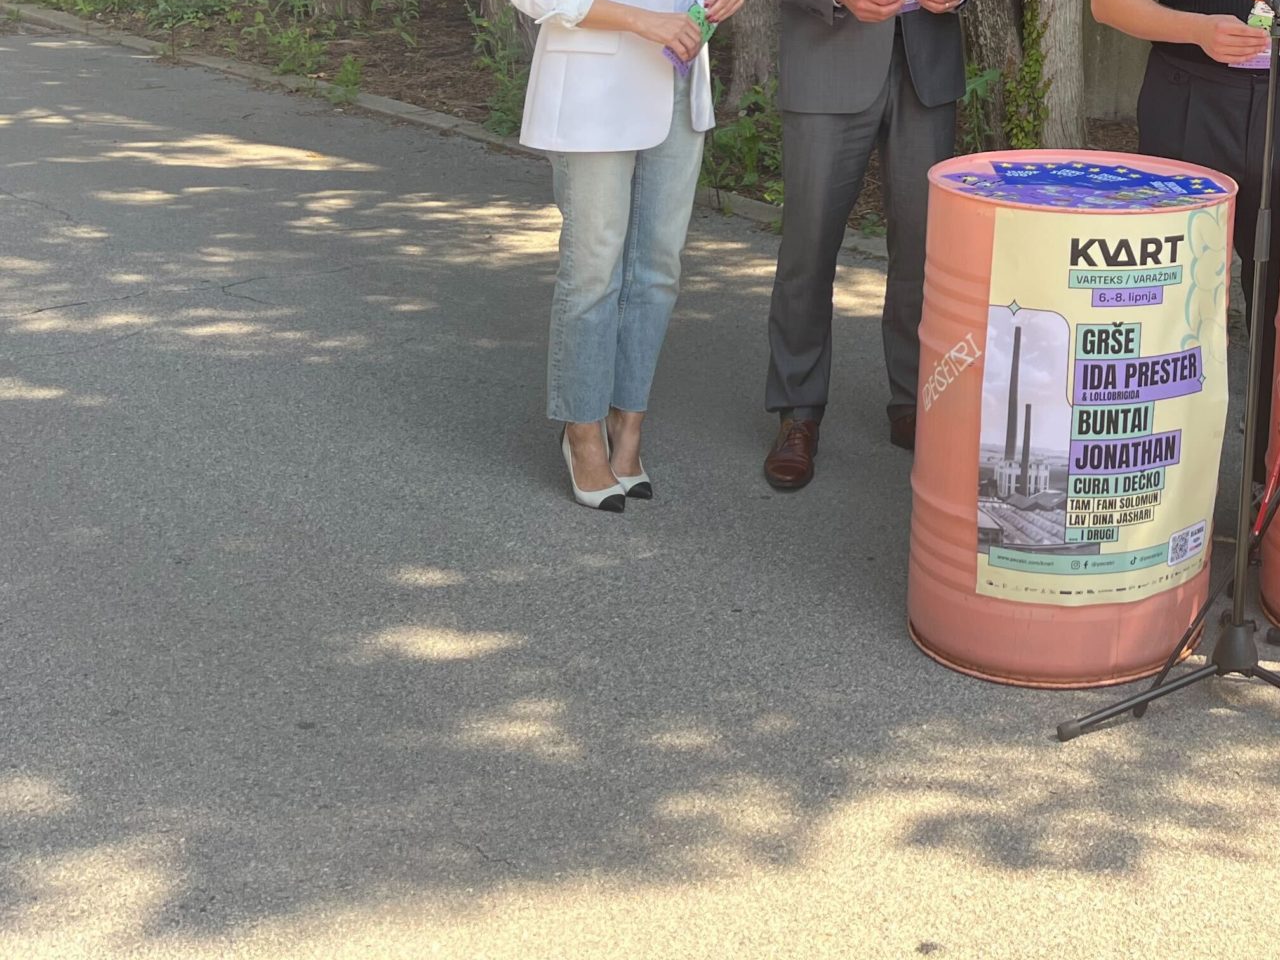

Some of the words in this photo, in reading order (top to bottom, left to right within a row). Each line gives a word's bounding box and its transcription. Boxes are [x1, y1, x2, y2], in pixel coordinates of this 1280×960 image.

[1070, 235, 1184, 267] KVART
[1076, 275, 1123, 285] VARTEKS
[1133, 270, 1178, 284] VARAŽDIN
[1099, 292, 1126, 303] 6.-8.
[1128, 291, 1157, 304] lipnja
[1082, 322, 1135, 355] GRŠE
[1082, 363, 1116, 390] IDA
[1124, 352, 1197, 389] PRESTER
[1081, 391, 1088, 401] &
[1089, 390, 1140, 402] LOLLOBRIGIDA
[1077, 406, 1149, 435] BUNTAI
[1075, 435, 1176, 470] JONATHAN
[1073, 477, 1110, 494] CURA
[1114, 477, 1119, 493] I
[1122, 469, 1160, 493] DEČKO
[1069, 499, 1091, 511] TAM
[1096, 497, 1117, 511] FANI
[1119, 491, 1158, 509] SOLOMUN
[1069, 514, 1087, 526] LAV
[1092, 512, 1114, 526] DINA
[1116, 508, 1152, 525] JASHARI
[1080, 529, 1085, 541] I
[1087, 528, 1115, 541] DRUGI
